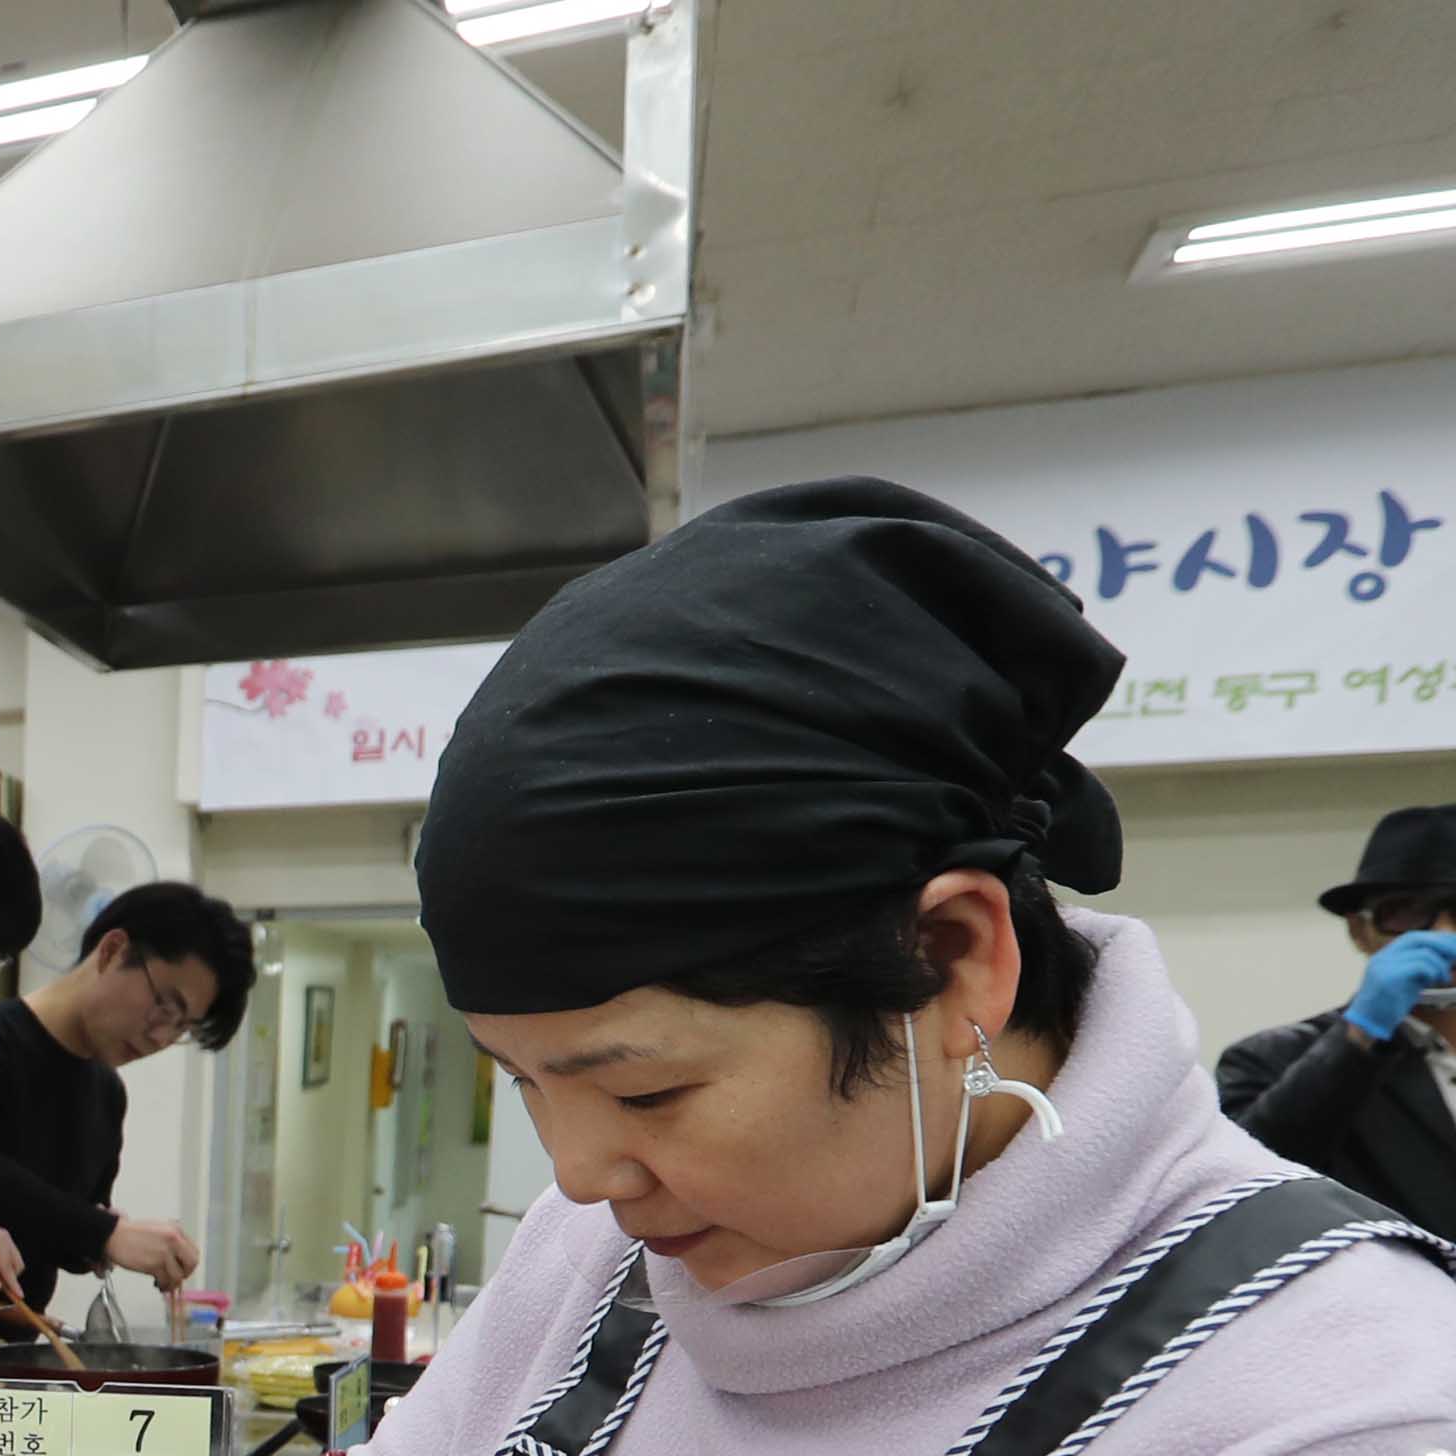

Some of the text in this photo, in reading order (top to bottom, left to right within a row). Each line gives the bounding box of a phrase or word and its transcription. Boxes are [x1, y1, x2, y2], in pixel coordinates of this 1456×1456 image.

[1213, 672, 1317, 713] 동구
[1343, 660, 1456, 704] 여성
[352, 724, 426, 762] 일시
[129, 1409, 155, 1453] 7
